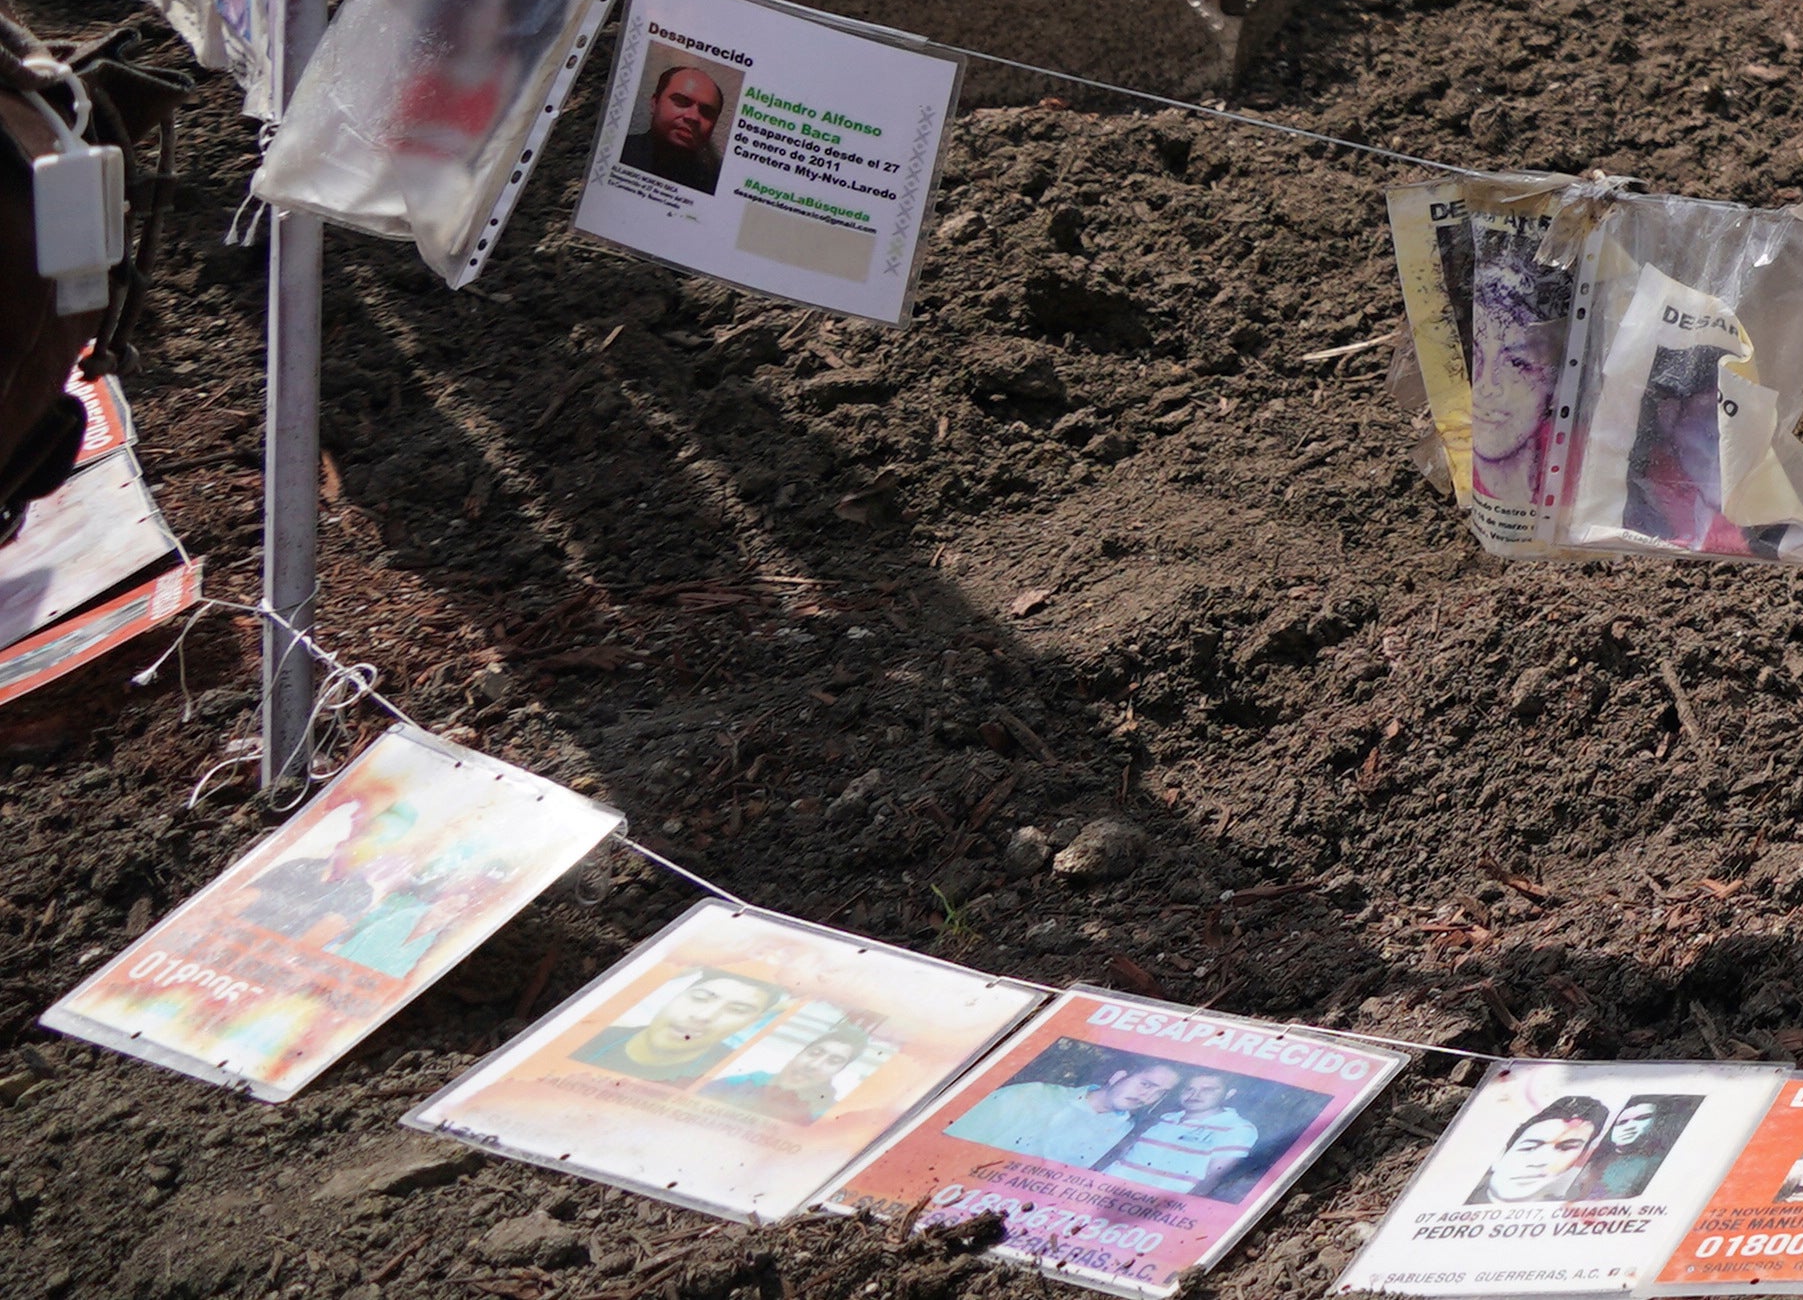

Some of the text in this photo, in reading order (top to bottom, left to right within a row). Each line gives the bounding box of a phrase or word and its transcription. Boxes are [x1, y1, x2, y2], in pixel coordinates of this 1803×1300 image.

[648, 21, 754, 67] Desaparecido
[741, 104, 841, 144] Moreno Baca
[745, 87, 882, 137] Alejandro Alfonso
[734, 133, 840, 172] de enero de 2011
[737, 118, 900, 174] Desaparecido desde el 27
[734, 146, 897, 200] Carretera Mty-Nvo.Laredo
[1088, 1000, 1371, 1083] DESAPARECIDO
[1412, 1219, 1651, 1241] PEDRO SOTO VAZQUEZ
